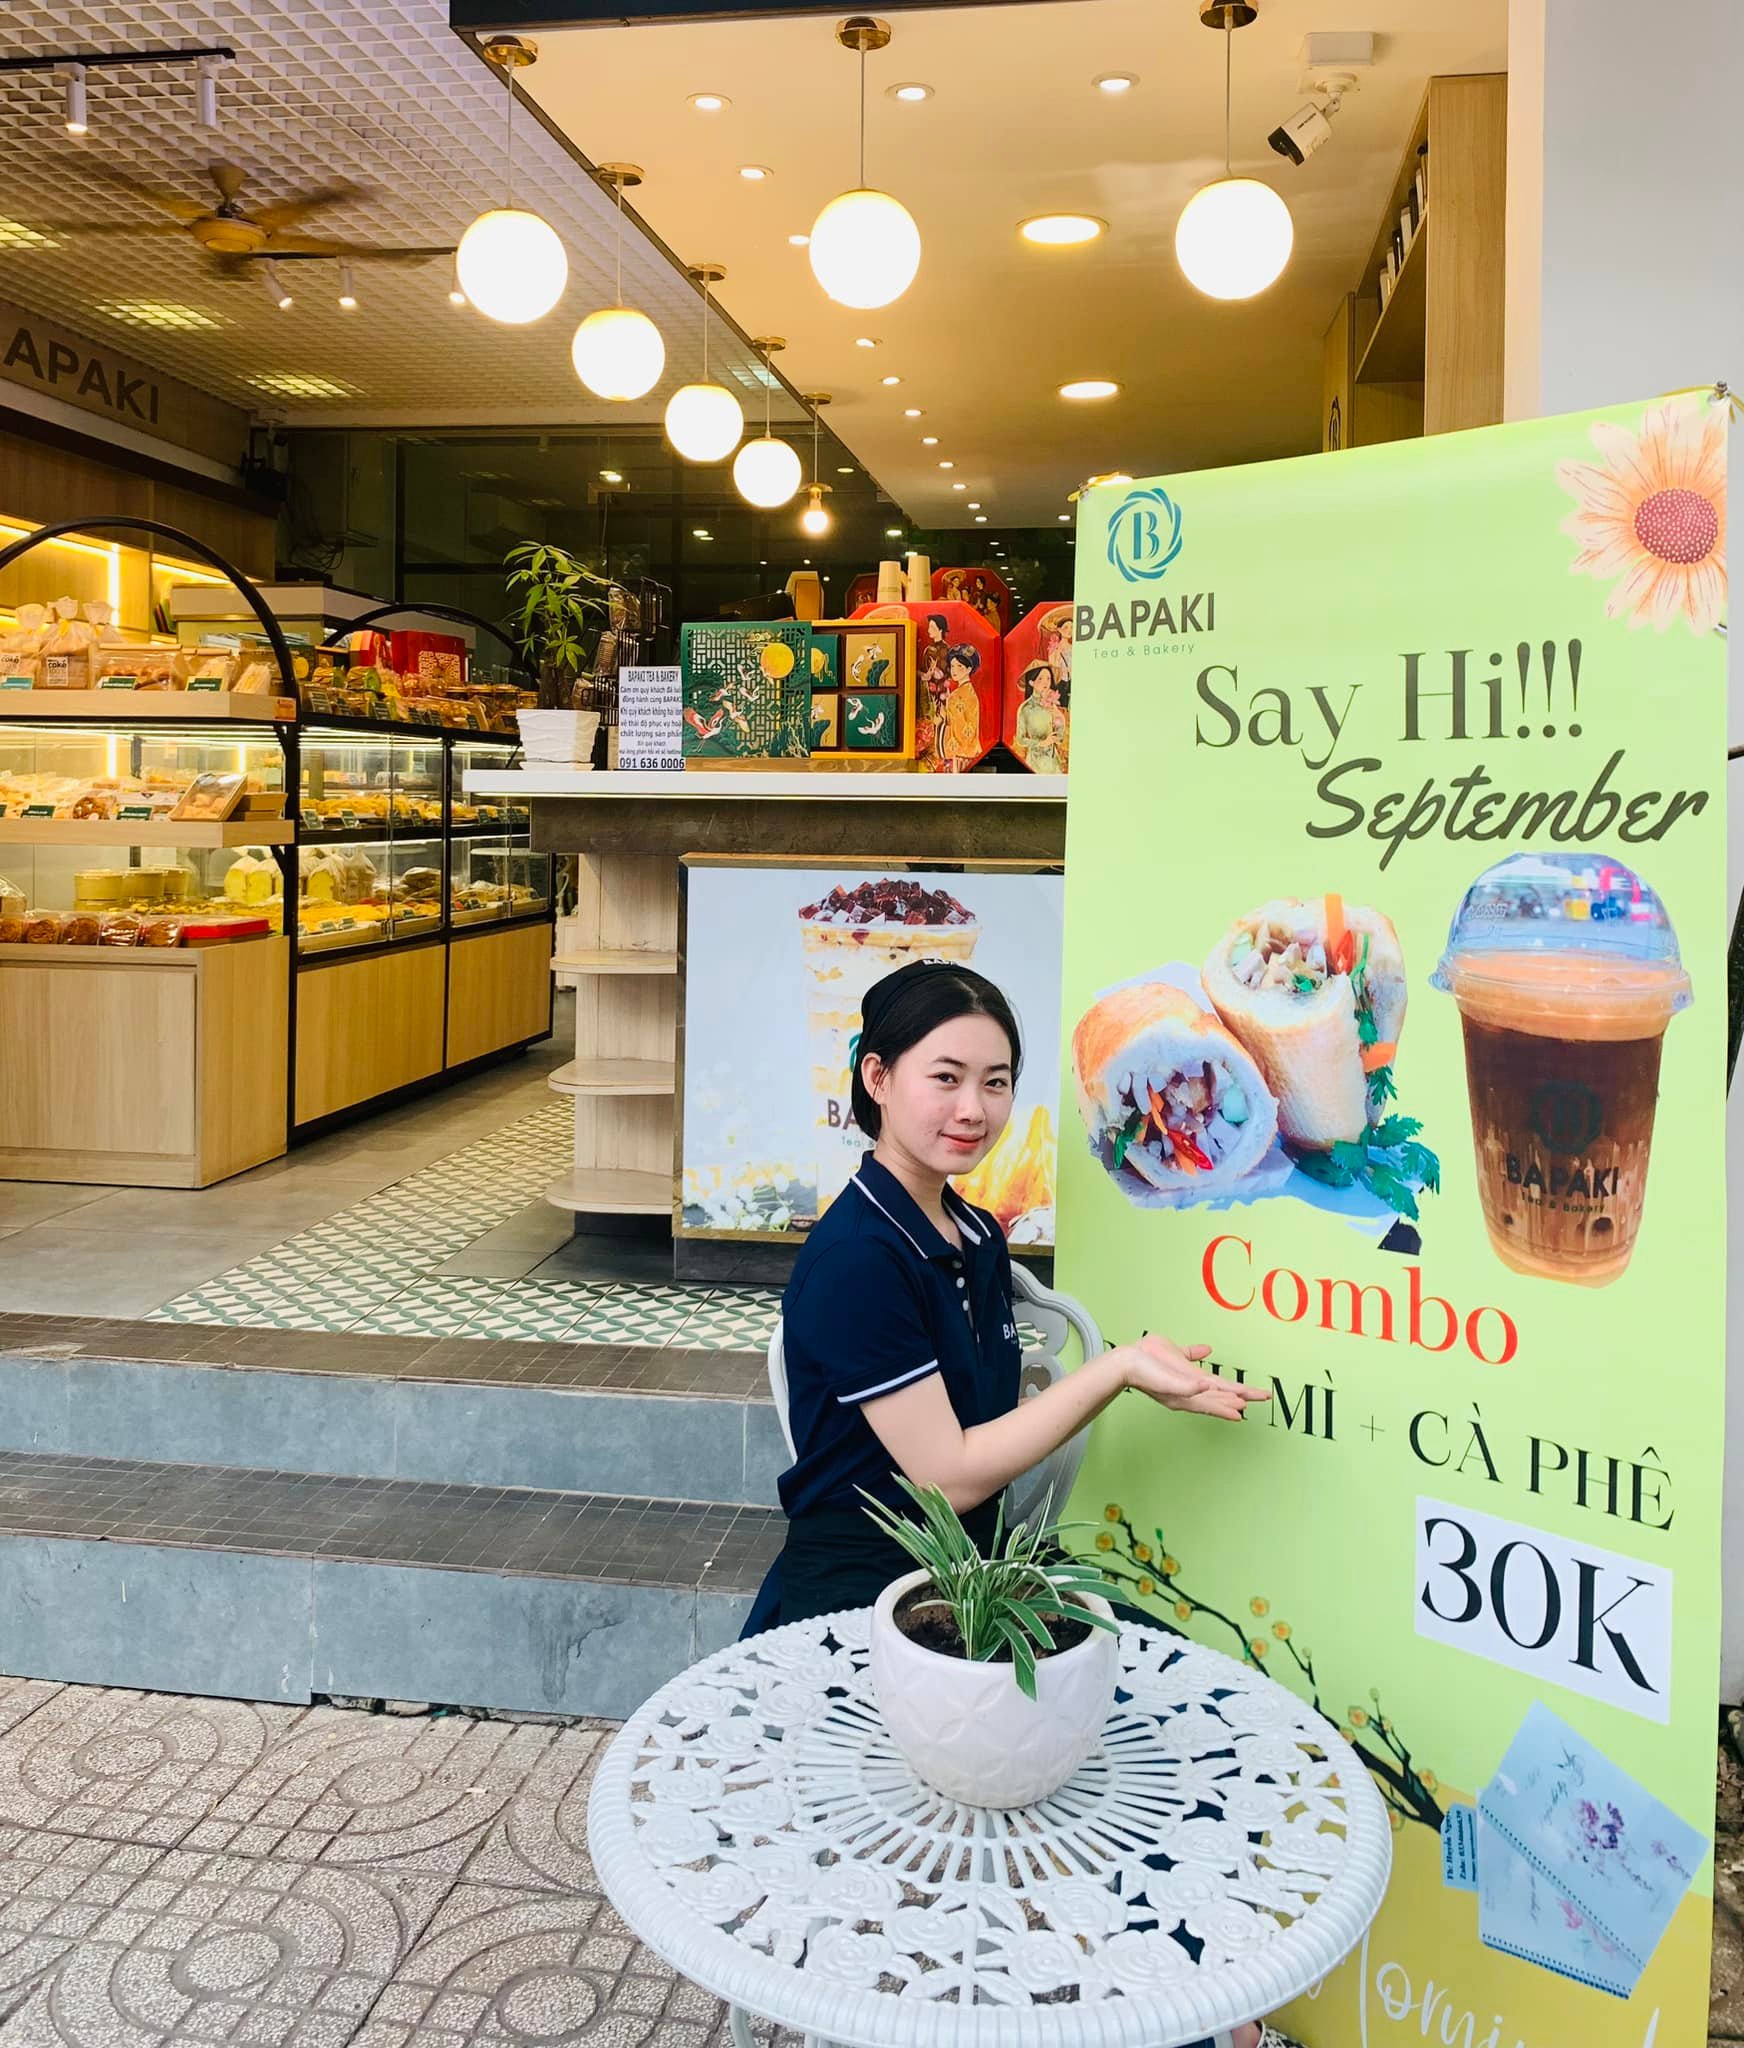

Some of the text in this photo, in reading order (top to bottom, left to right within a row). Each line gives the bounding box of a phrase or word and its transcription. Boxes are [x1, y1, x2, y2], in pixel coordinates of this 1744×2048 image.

[3, 327, 160, 425] APAKI
[1075, 592, 1215, 642] BAPAKI
[1093, 643, 1195, 659] Tea & Bakery
[661, 670, 679, 682] BAKERY
[1196, 638, 1582, 770] Say Hi!!!
[620, 757, 684, 768] 091 636 0006
[1305, 749, 1710, 871] September
[1506, 1152, 1619, 1199] BAPAKI
[1563, 1204, 1604, 1214] Bakery
[1202, 1234, 1519, 1366] Combo
[1268, 1369, 1338, 1441] MÌ
[1409, 1402, 1504, 1484] CÀ
[1526, 1434, 1676, 1531] PHÊ
[1421, 1518, 1660, 1695] 30K
